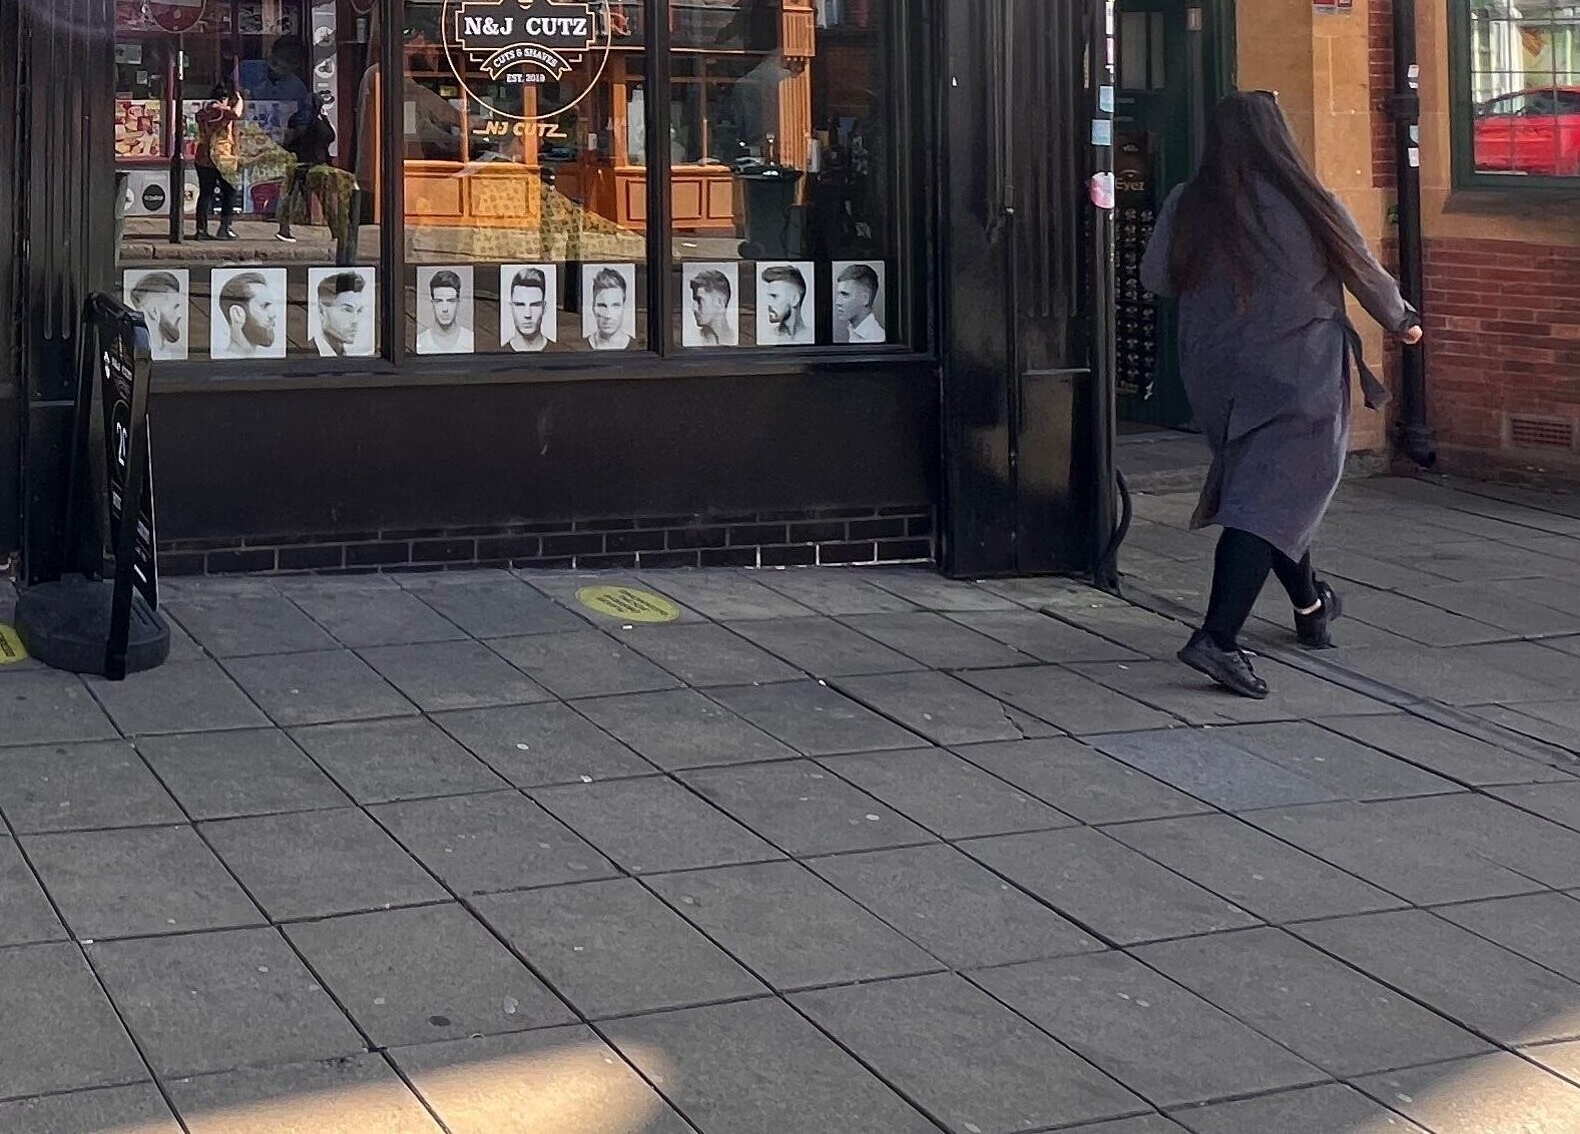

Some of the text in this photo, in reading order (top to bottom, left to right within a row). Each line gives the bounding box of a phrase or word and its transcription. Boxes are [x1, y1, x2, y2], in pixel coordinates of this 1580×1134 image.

[464, 17, 588, 35] N&J CUTZ
[493, 48, 516, 67] CUTS
[513, 122, 559, 137] CUTZ
